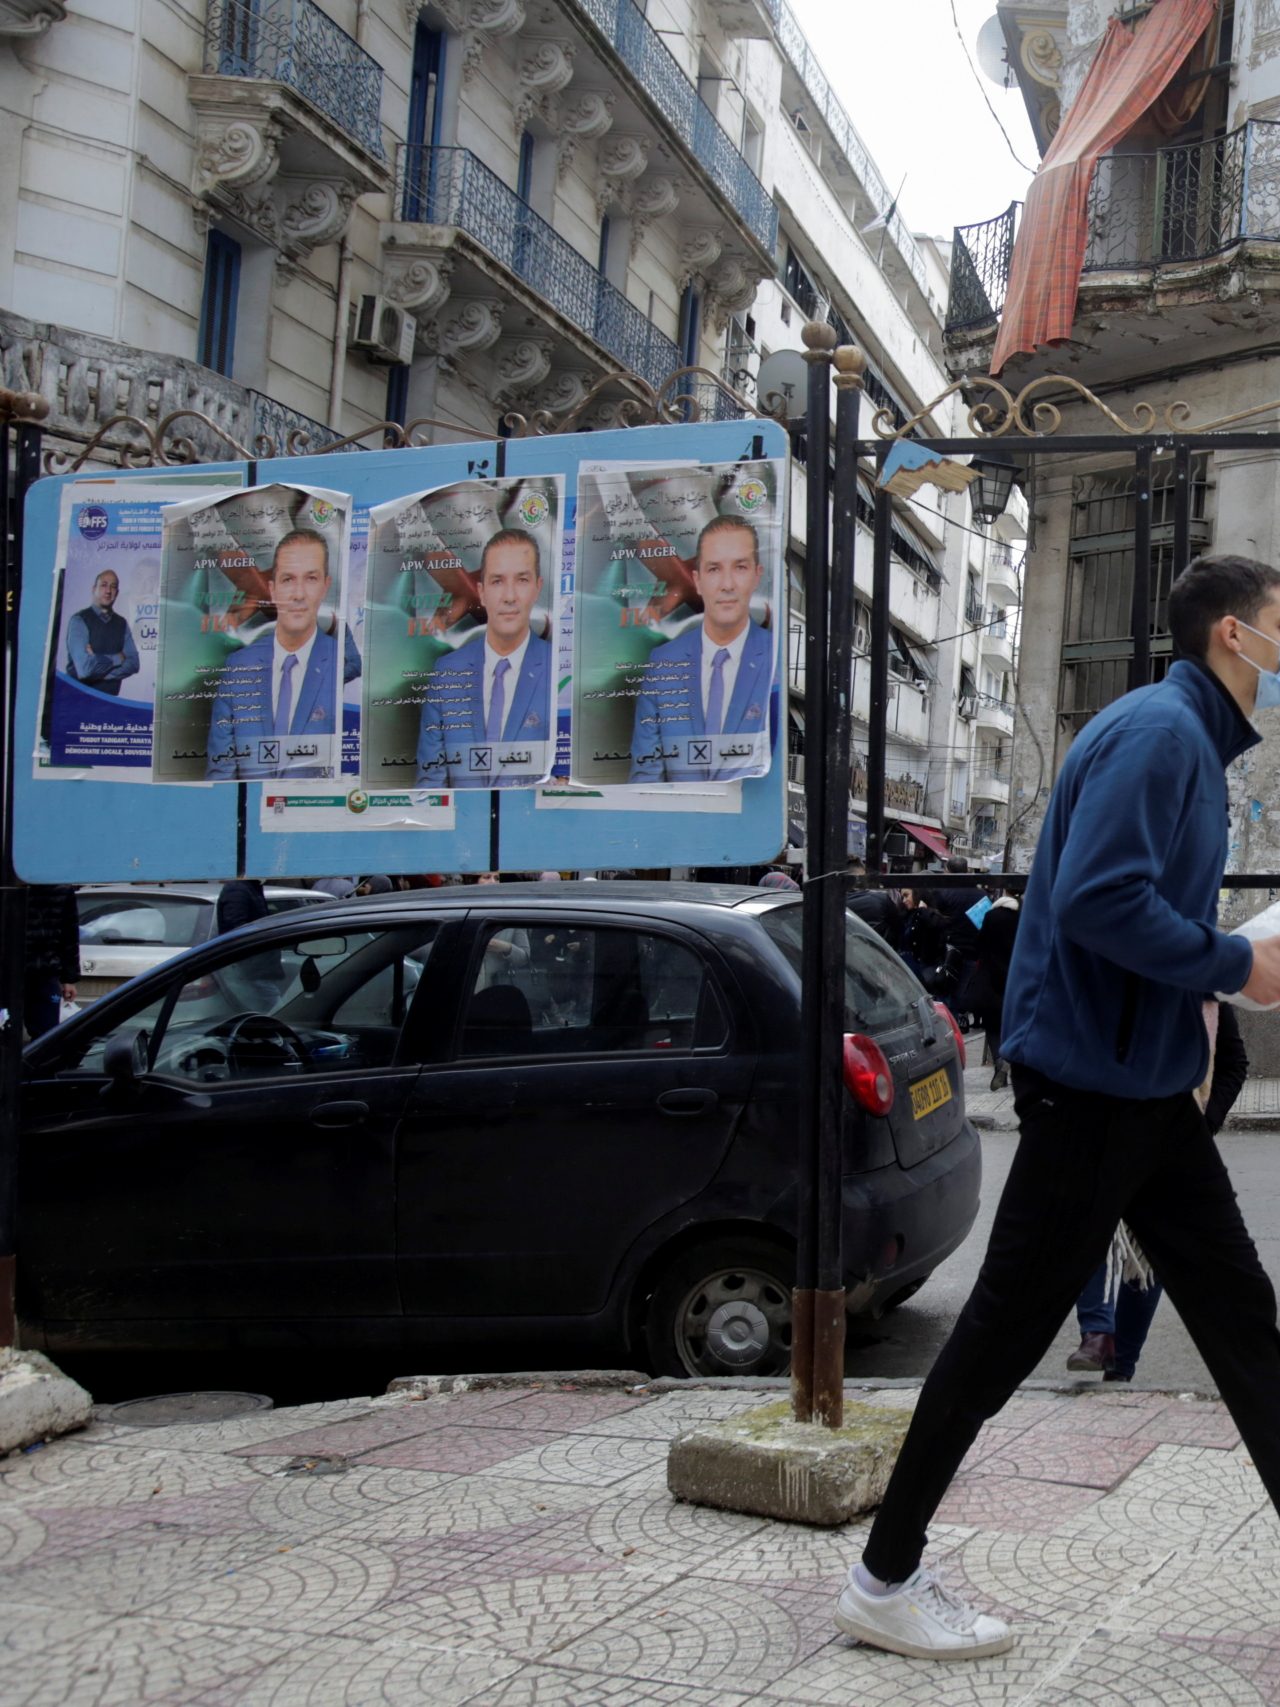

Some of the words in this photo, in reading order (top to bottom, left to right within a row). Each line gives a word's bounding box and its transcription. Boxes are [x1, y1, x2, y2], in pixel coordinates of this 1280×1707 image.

[610, 549, 637, 560] APW
[639, 546, 677, 558] ALGER
[193, 559, 218, 569] APW
[220, 557, 256, 568] ALGER
[400, 560, 424, 571] APW
[427, 559, 462, 569] ALGER
[137, 605, 159, 616] VOT
[172, 750, 208, 760] محمد
[422, 751, 462, 770] شلابي
[593, 751, 632, 762] محمد
[637, 746, 680, 765] شلابي
[381, 756, 417, 767] محمد
